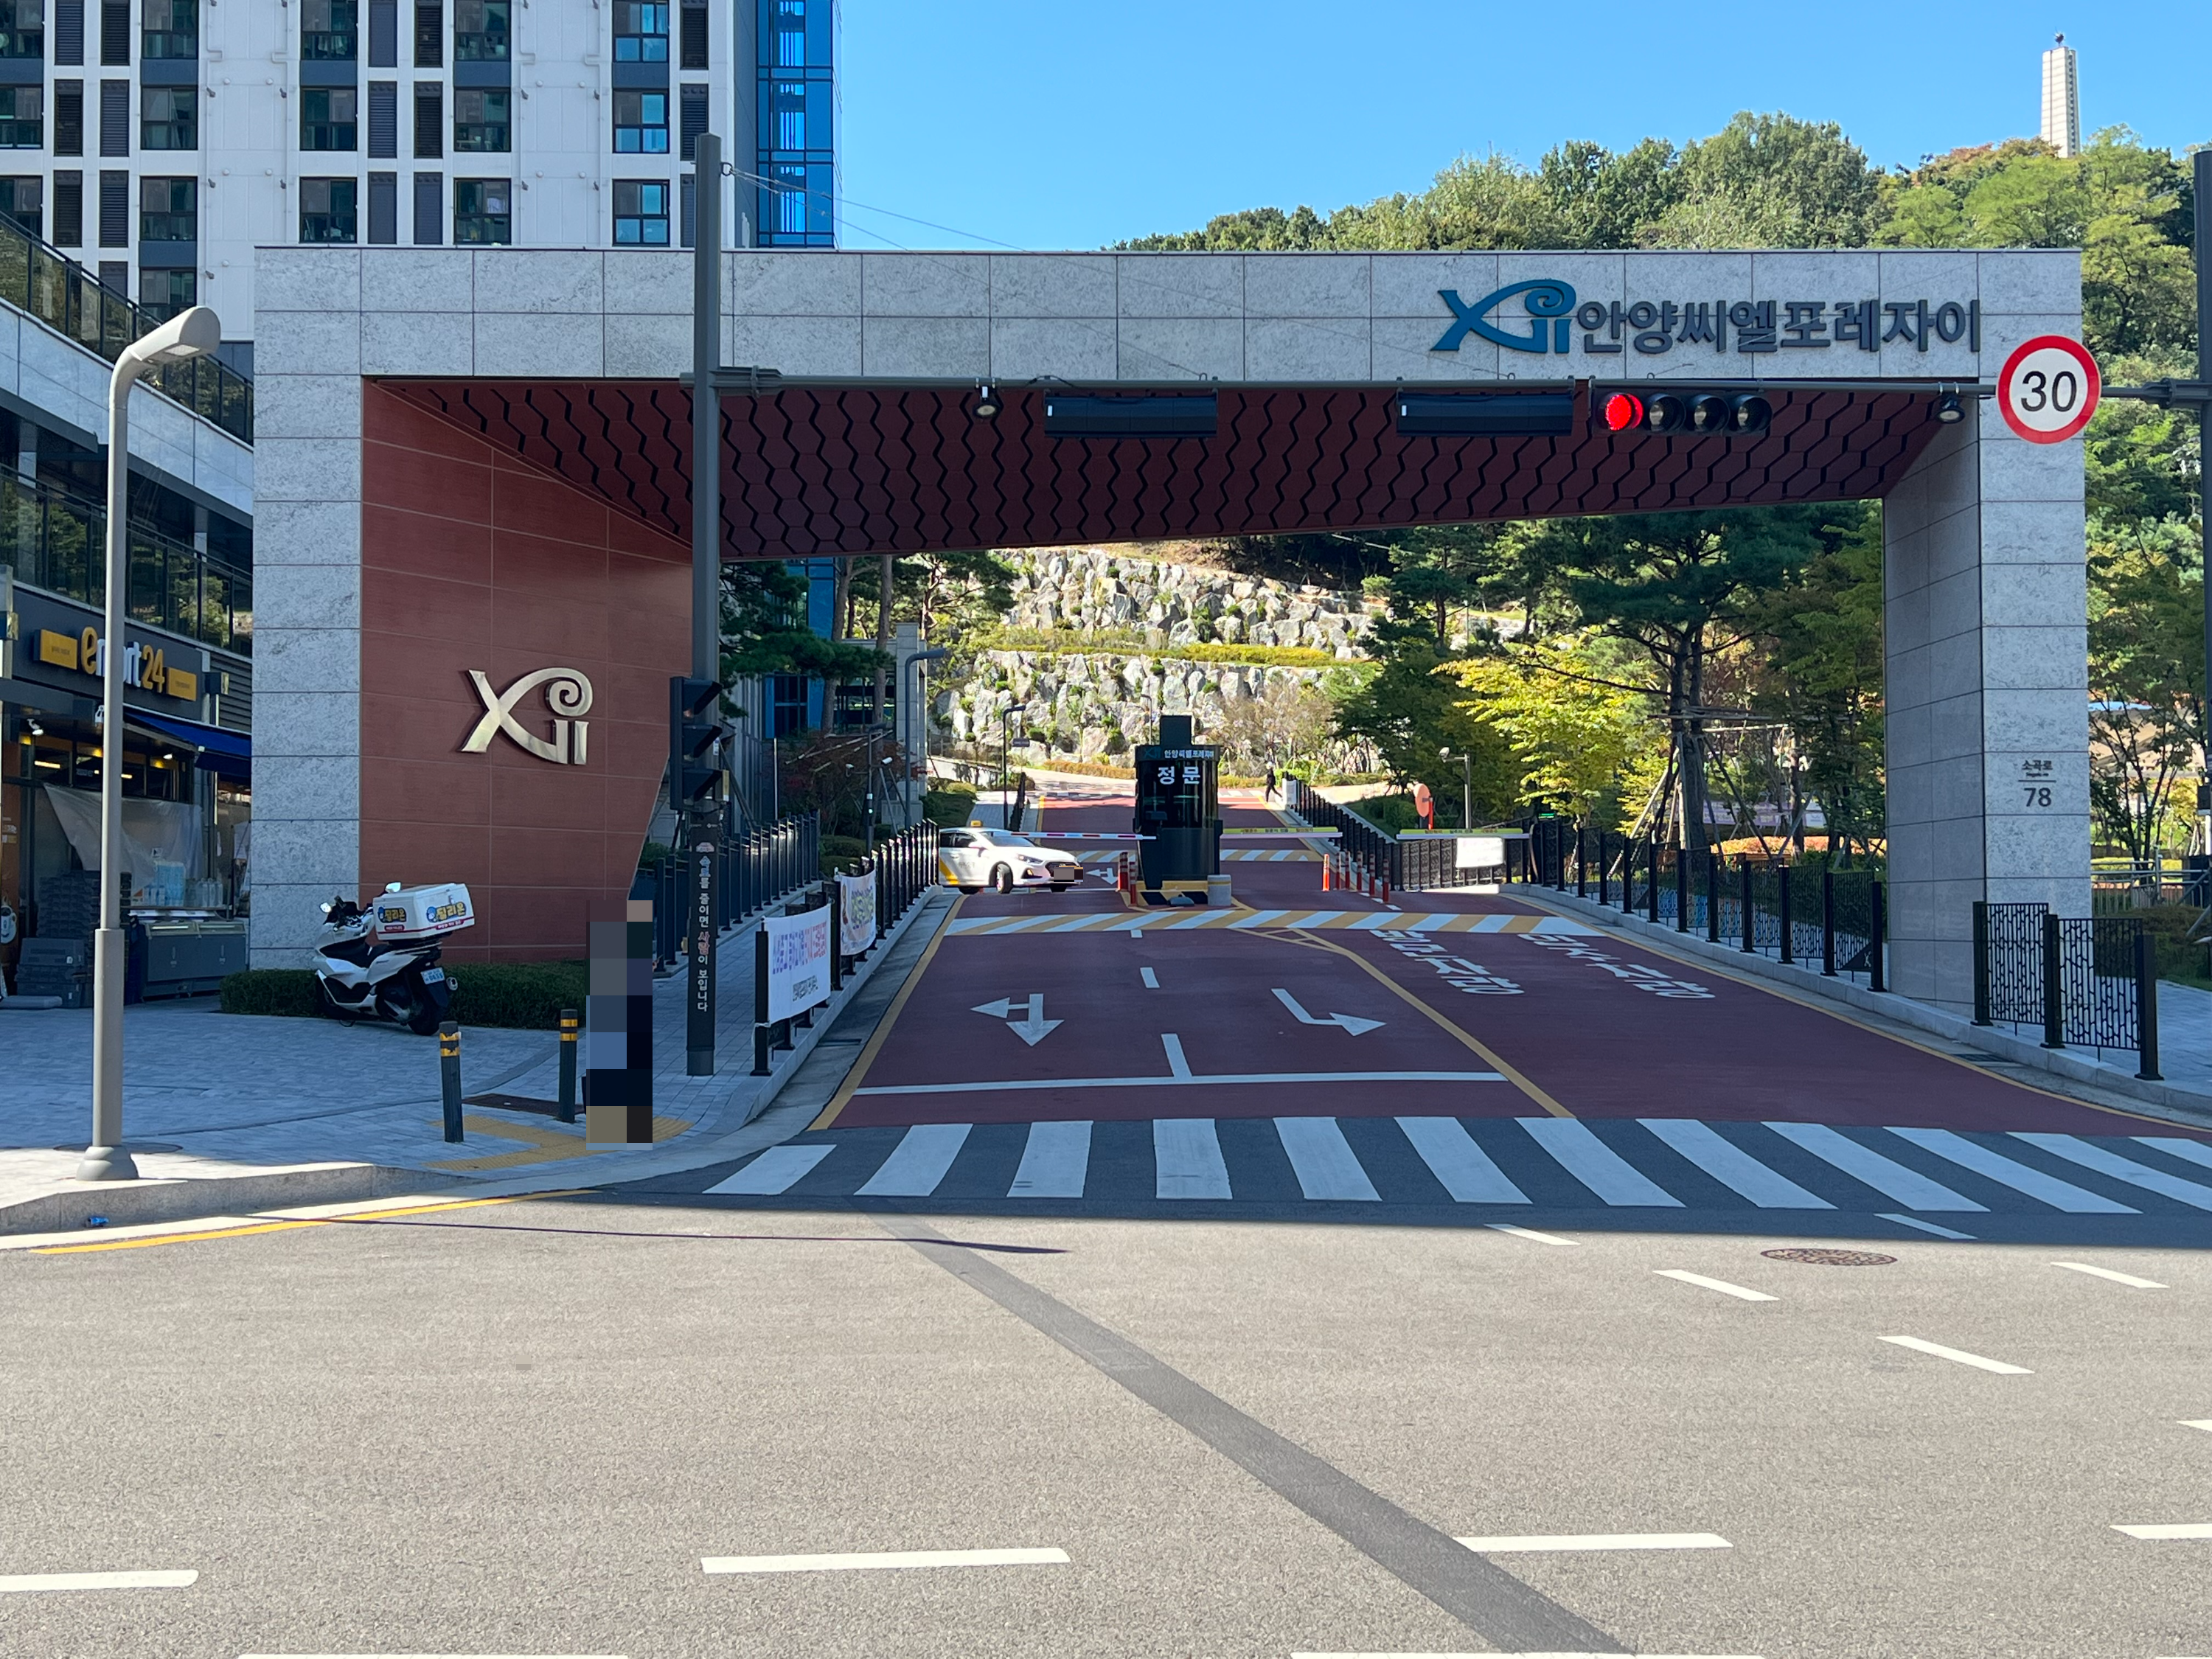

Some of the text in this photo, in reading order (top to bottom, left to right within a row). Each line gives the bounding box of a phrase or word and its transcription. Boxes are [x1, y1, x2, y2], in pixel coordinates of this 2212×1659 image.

[1577, 299, 1980, 354] 안양씨엘포레자이
[2020, 370, 2077, 411] 30
[81, 626, 165, 694] ert24
[1158, 766, 1200, 785] 정문
[2022, 759, 2053, 771] 소곡로
[2023, 787, 2052, 807] 78
[698, 892, 710, 928] 줄이면
[698, 931, 711, 965] 사람이
[1368, 929, 1525, 995] 방문차량
[1517, 933, 1716, 999] 입주차량
[697, 969, 709, 1012] 보입니다
